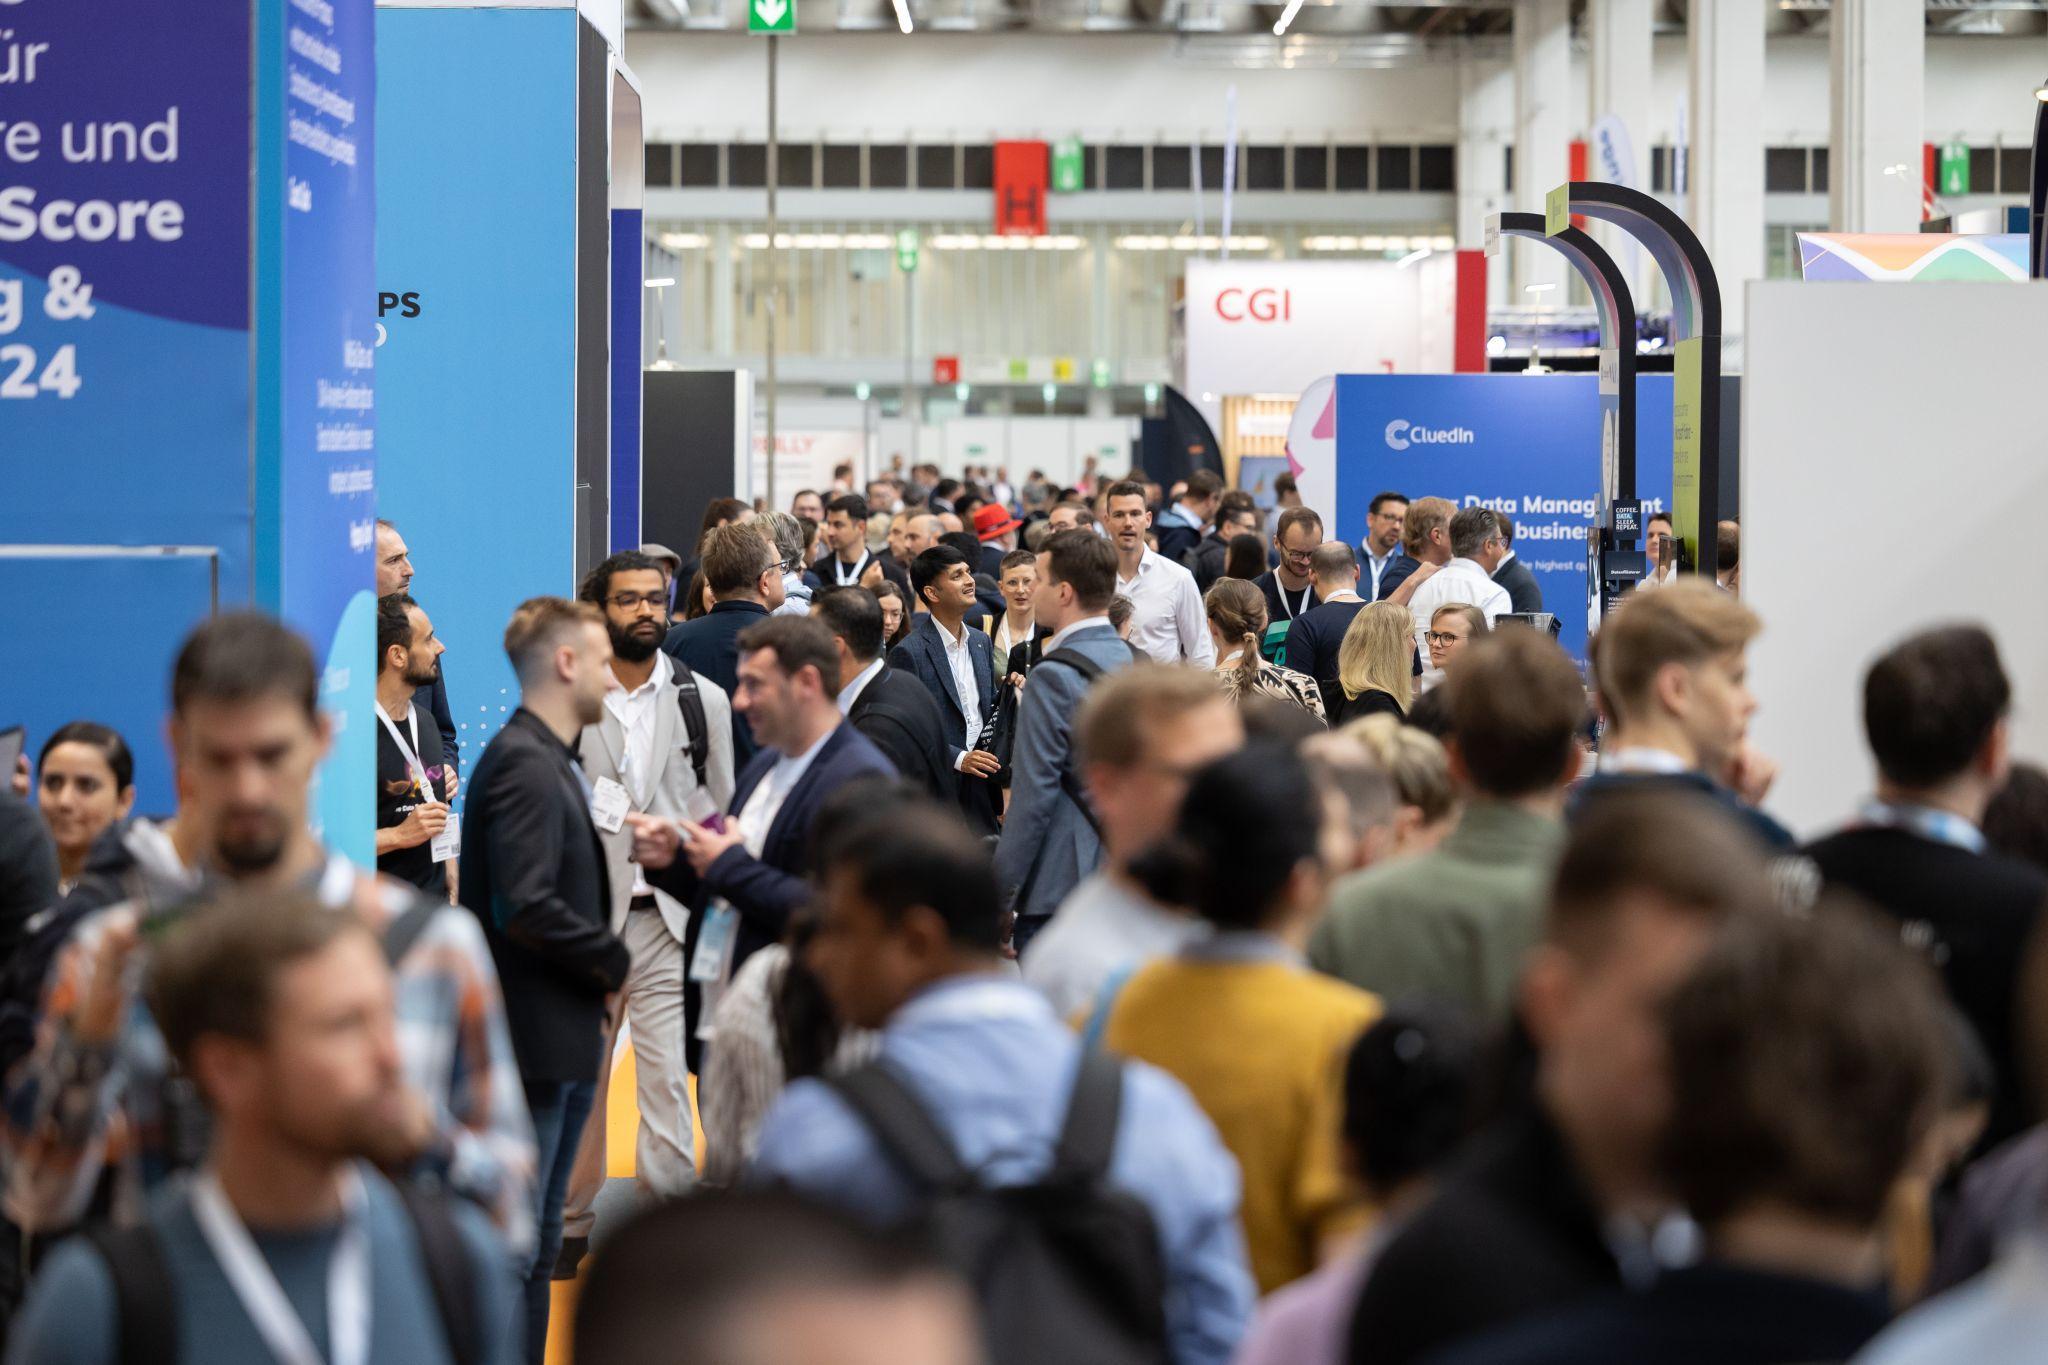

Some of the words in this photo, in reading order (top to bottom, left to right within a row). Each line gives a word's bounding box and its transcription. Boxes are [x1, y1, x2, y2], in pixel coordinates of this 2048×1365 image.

[61, 106, 179, 163] und
[0, 186, 185, 242] Score
[43, 264, 97, 321] &
[378, 291, 421, 318] PS
[1215, 287, 1290, 322] CGI
[0, 343, 82, 399] 24
[1409, 425, 1475, 444] CluedIn
[1464, 494, 1517, 514] Data
[1523, 494, 1663, 518] Managnt
